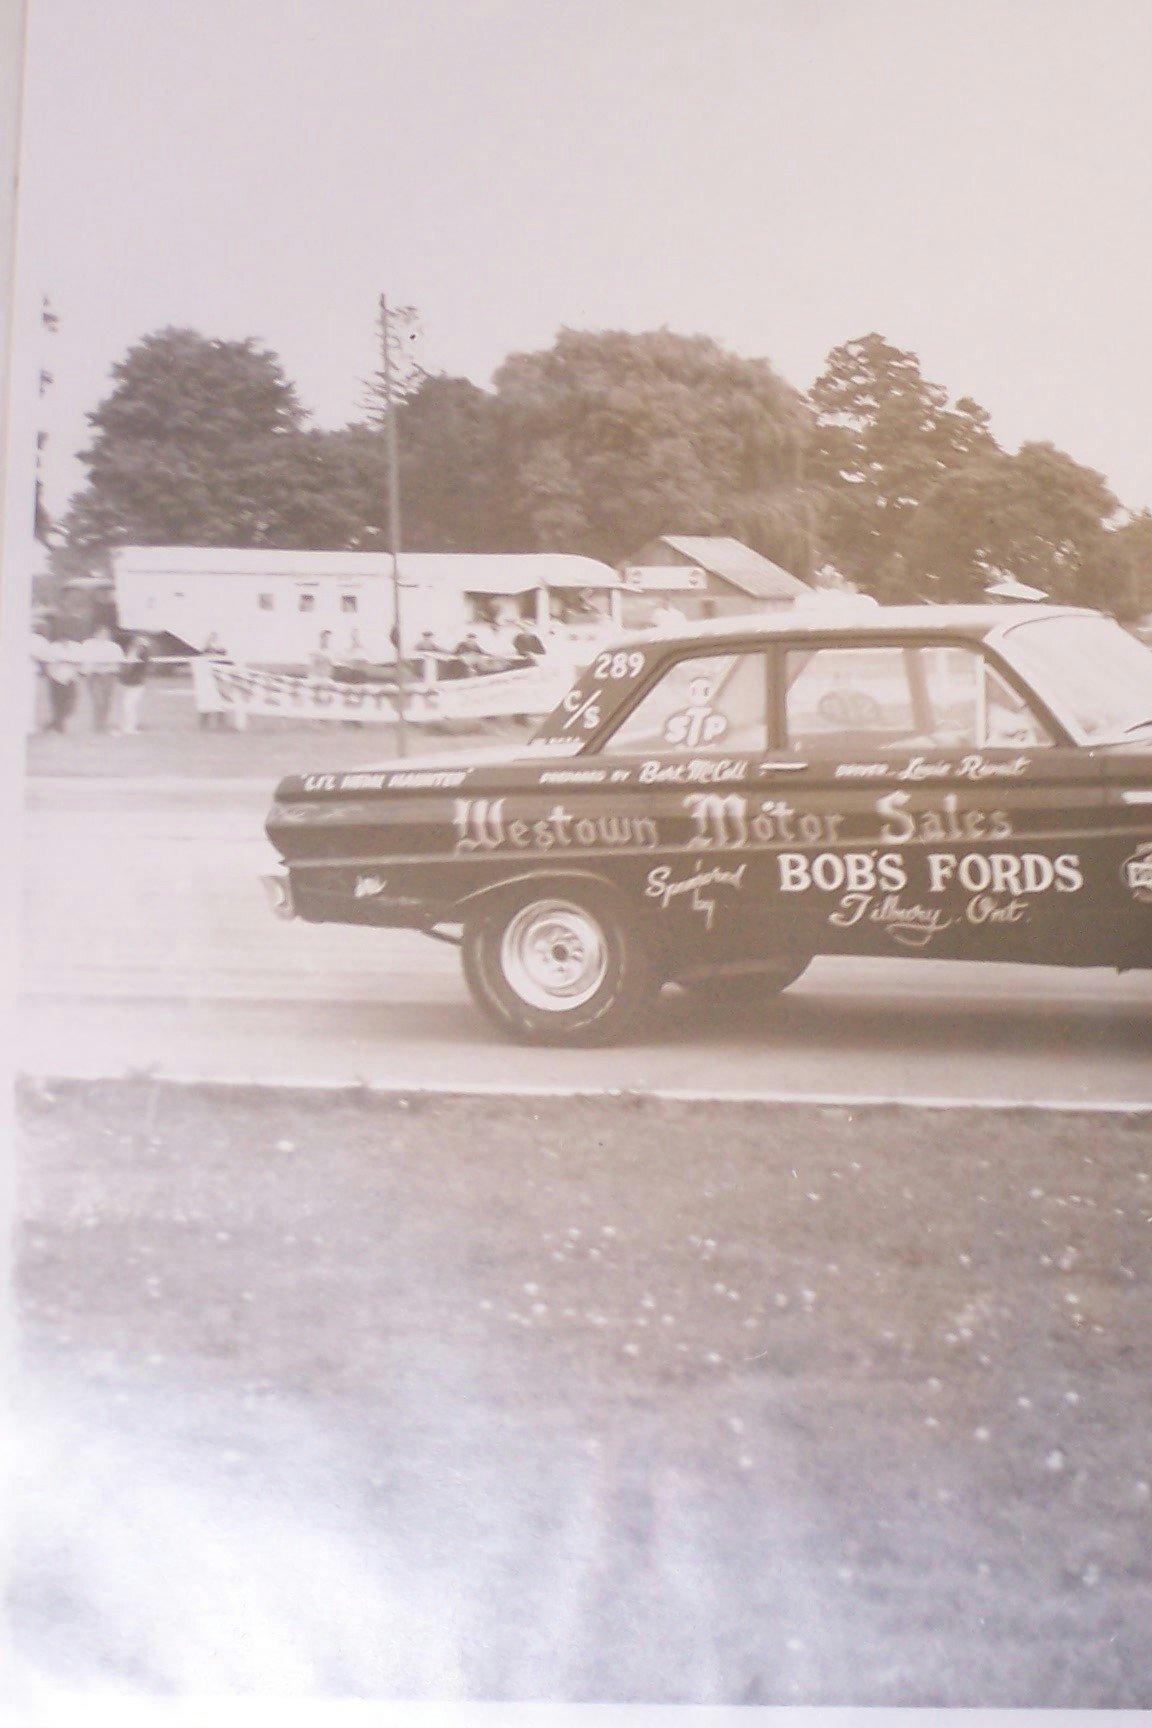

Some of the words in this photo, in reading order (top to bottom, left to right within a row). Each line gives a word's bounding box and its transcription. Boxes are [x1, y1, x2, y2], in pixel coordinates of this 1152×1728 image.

[594, 652, 646, 679] 289
[664, 705, 728, 748] STP
[452, 798, 658, 850] Westown
[682, 793, 845, 850] Motor
[876, 790, 1013, 845] Sales
[777, 850, 907, 892] BOB'S
[927, 853, 1084, 895] FORDS
